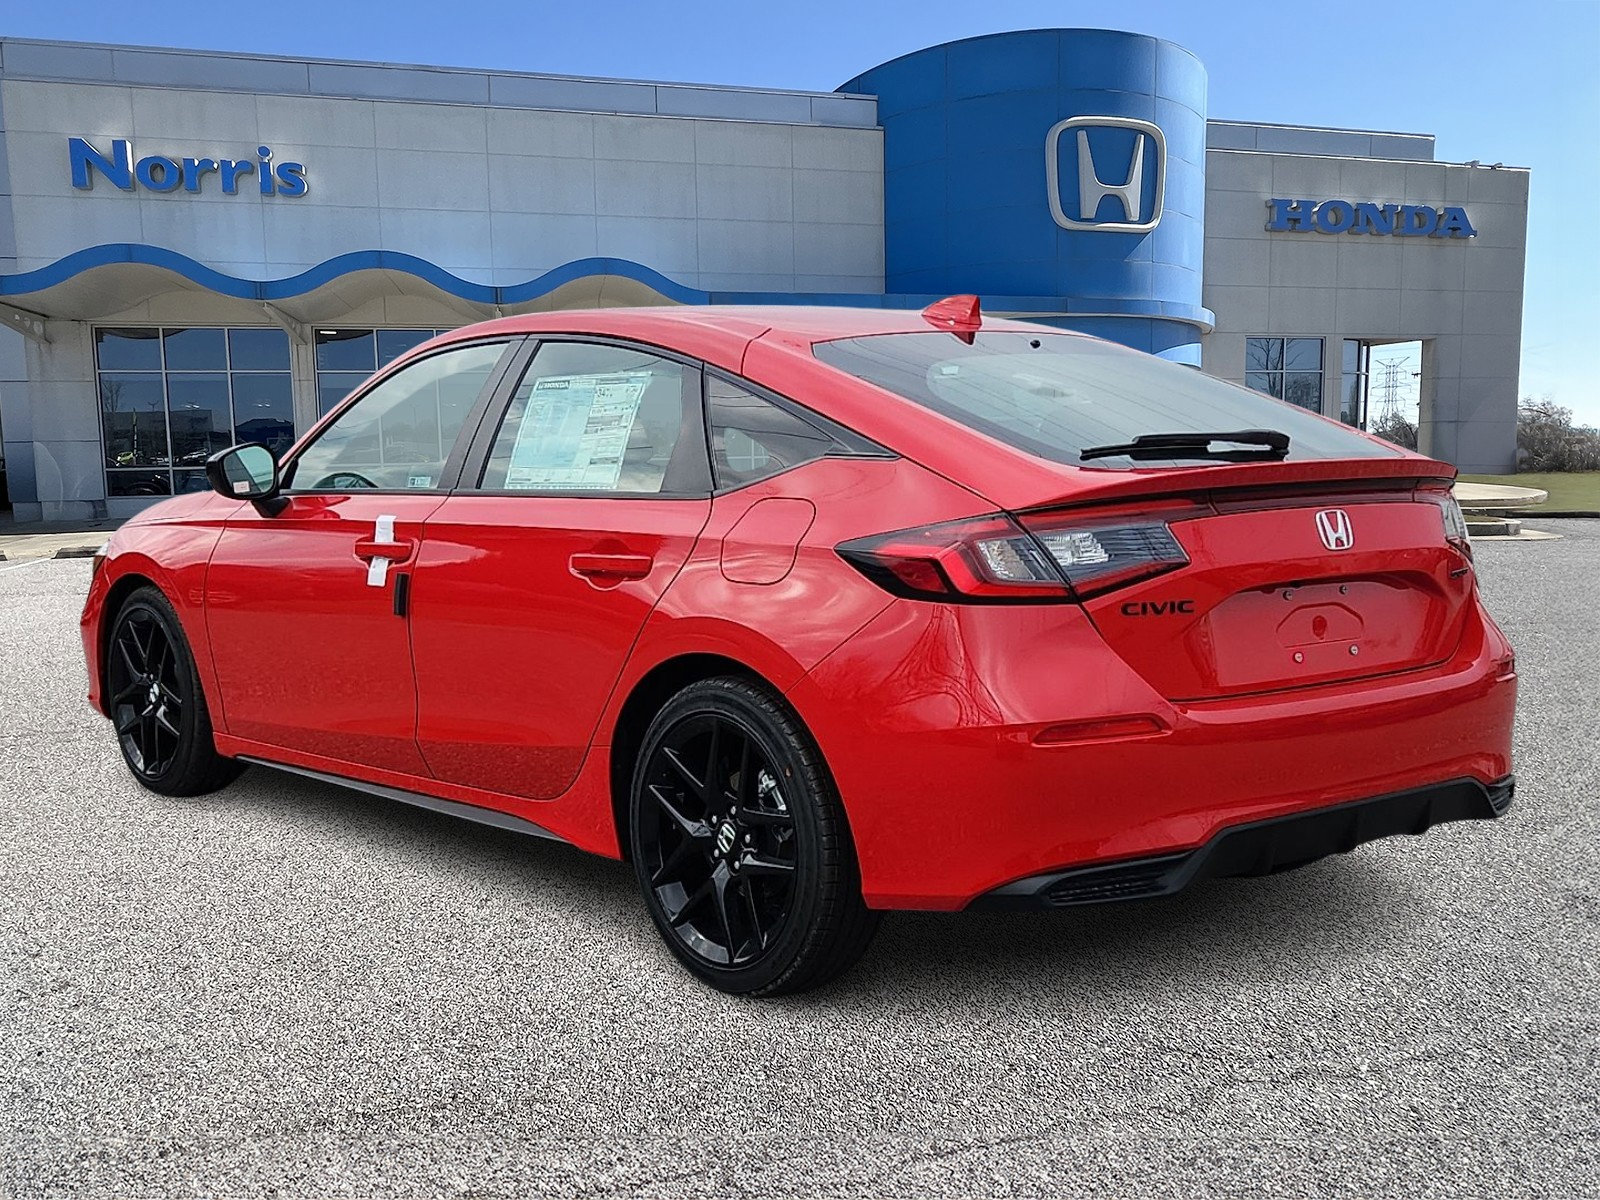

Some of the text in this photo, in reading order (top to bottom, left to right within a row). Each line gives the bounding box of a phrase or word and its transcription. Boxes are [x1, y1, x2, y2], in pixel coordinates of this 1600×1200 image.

[68, 137, 309, 197] Norris
[1266, 198, 1478, 239] HONDA
[1121, 600, 1194, 616] CIVIC
